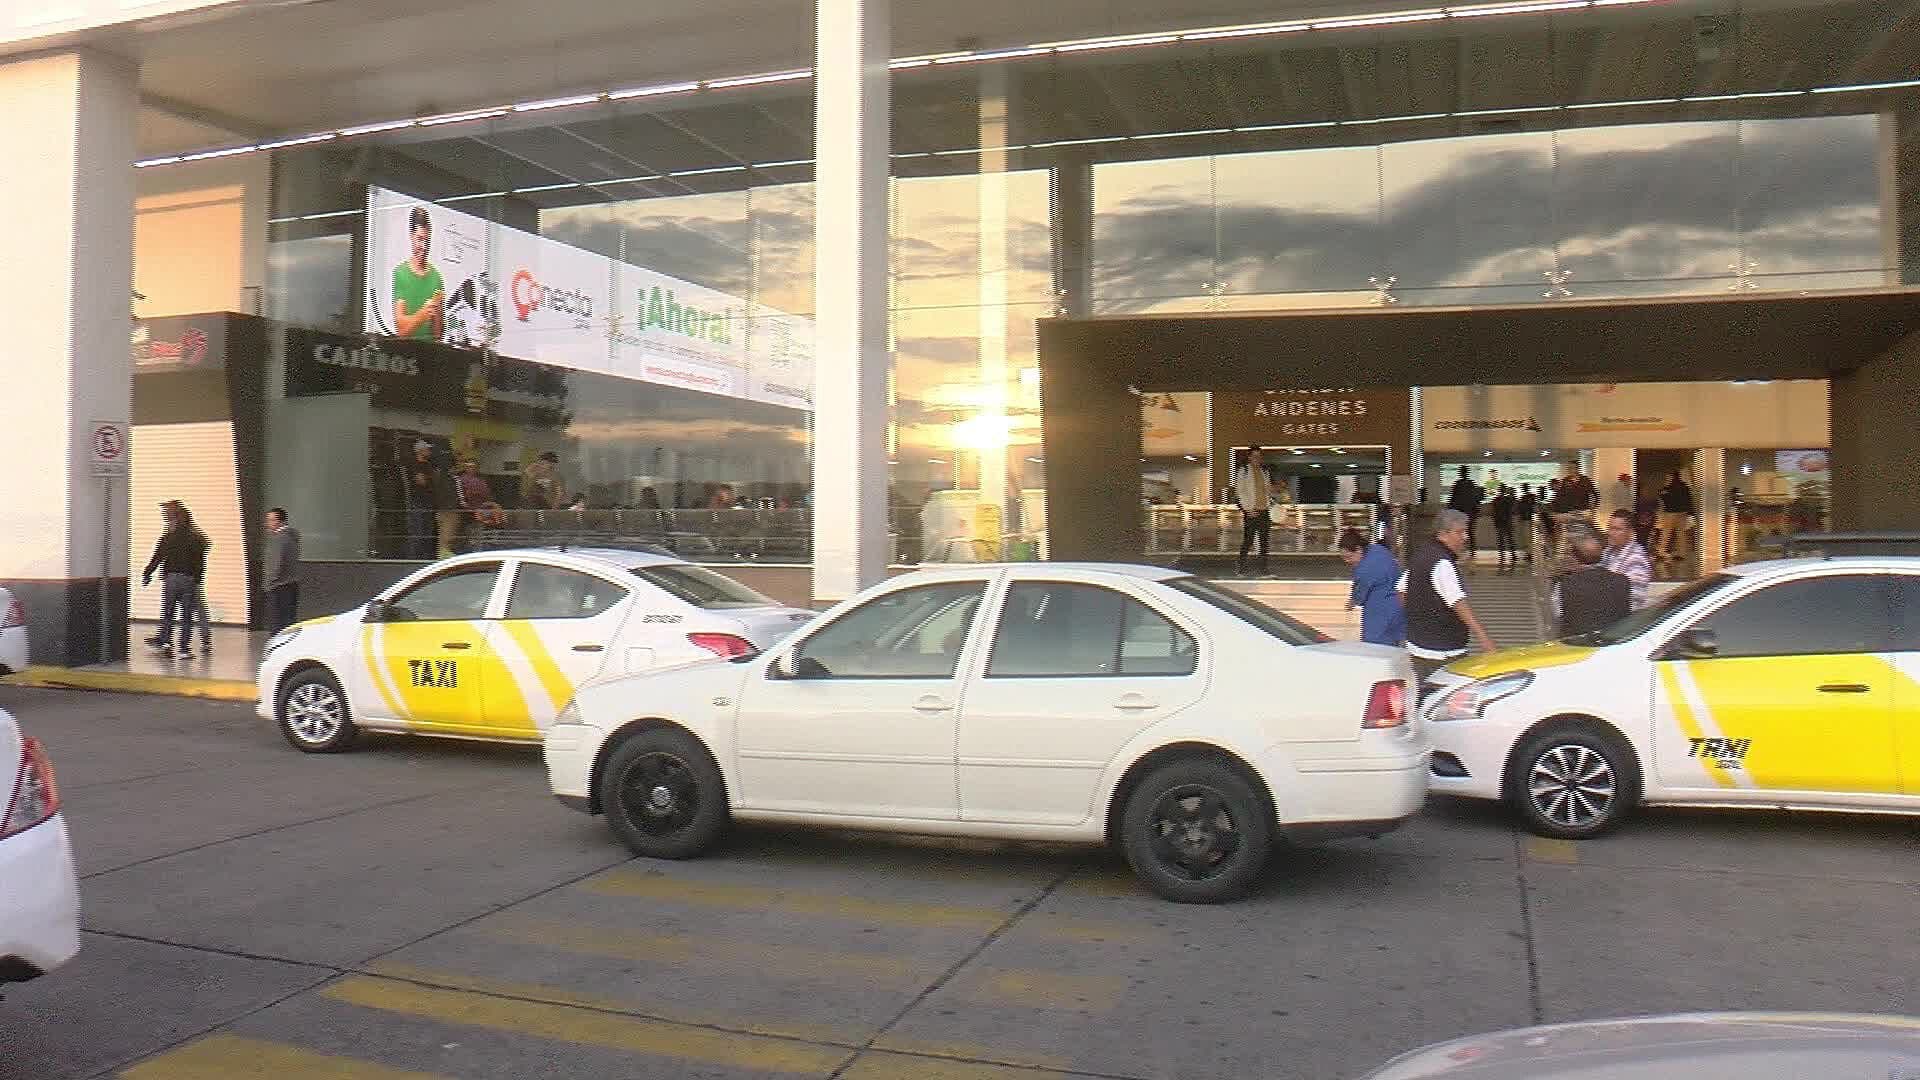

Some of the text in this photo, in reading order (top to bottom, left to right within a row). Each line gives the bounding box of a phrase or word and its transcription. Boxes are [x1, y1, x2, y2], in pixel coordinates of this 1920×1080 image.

[511, 269, 592, 321] Conecta
[636, 285, 733, 346] ¡Ahora!
[312, 343, 420, 376] CAJEROS
[1253, 400, 1367, 417] ANDENES
[1281, 422, 1340, 435] GATES
[407, 659, 458, 689] TAXI
[1687, 737, 1752, 759] TAXI
